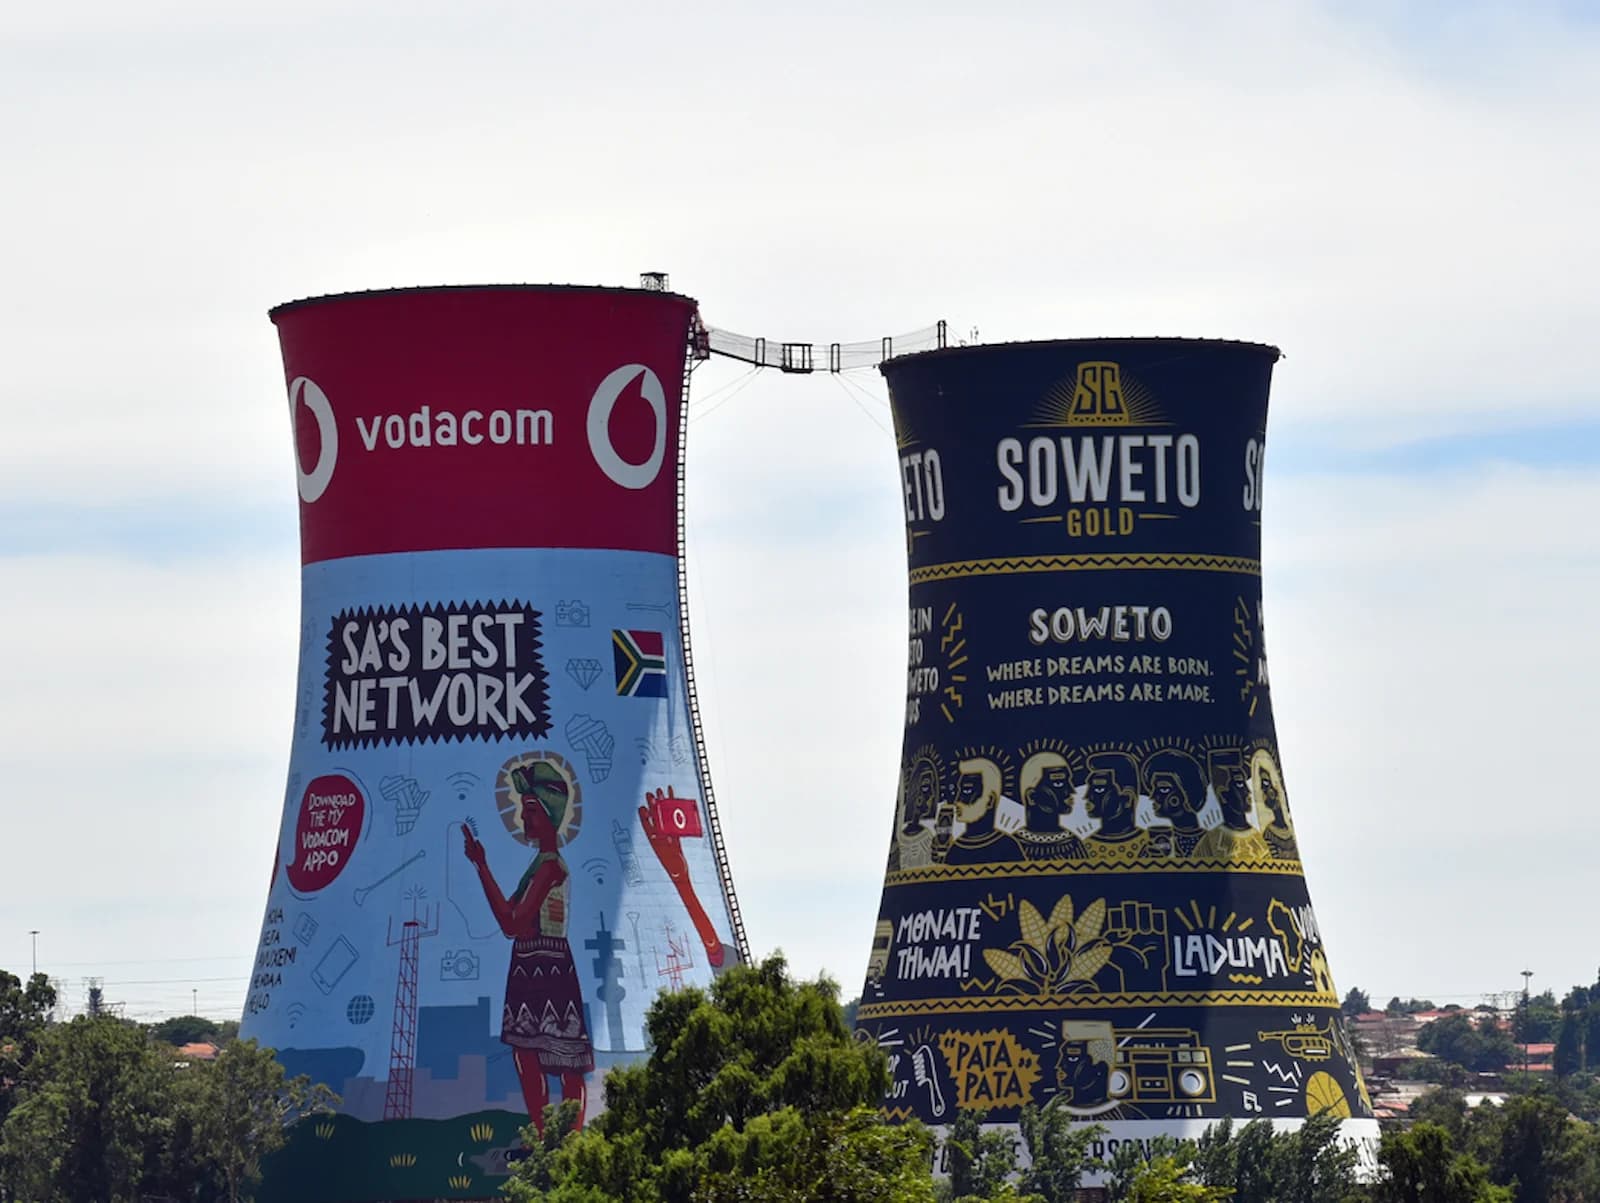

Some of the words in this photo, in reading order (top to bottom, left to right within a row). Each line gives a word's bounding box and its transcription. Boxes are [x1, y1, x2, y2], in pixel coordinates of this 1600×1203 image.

[356, 405, 554, 451] vodacom
[997, 433, 1201, 512] SOWETO
[1067, 507, 1134, 537] GOLD
[1029, 606, 1173, 645] SOWETO
[341, 617, 411, 676] SA'S
[422, 613, 525, 671] BEST
[986, 658, 1043, 682] WHERE
[1047, 654, 1126, 677] DREAMS
[1128, 655, 1163, 675] ARE
[1167, 656, 1215, 677] BORN.
[333, 671, 537, 735] NETWORK
[987, 686, 1045, 710] WHERE
[1048, 683, 1126, 705] DREAMS
[1129, 683, 1164, 702] ARE
[1167, 684, 1216, 704] MADE.
[310, 809, 327, 828] THE
[327, 809, 345, 826] MY
[302, 827, 350, 850] VODACOM
[896, 907, 982, 944] MONATE
[897, 943, 971, 980] THWAA!
[1173, 934, 1289, 978] LADUMA
[964, 1070, 1024, 1103] PATA
